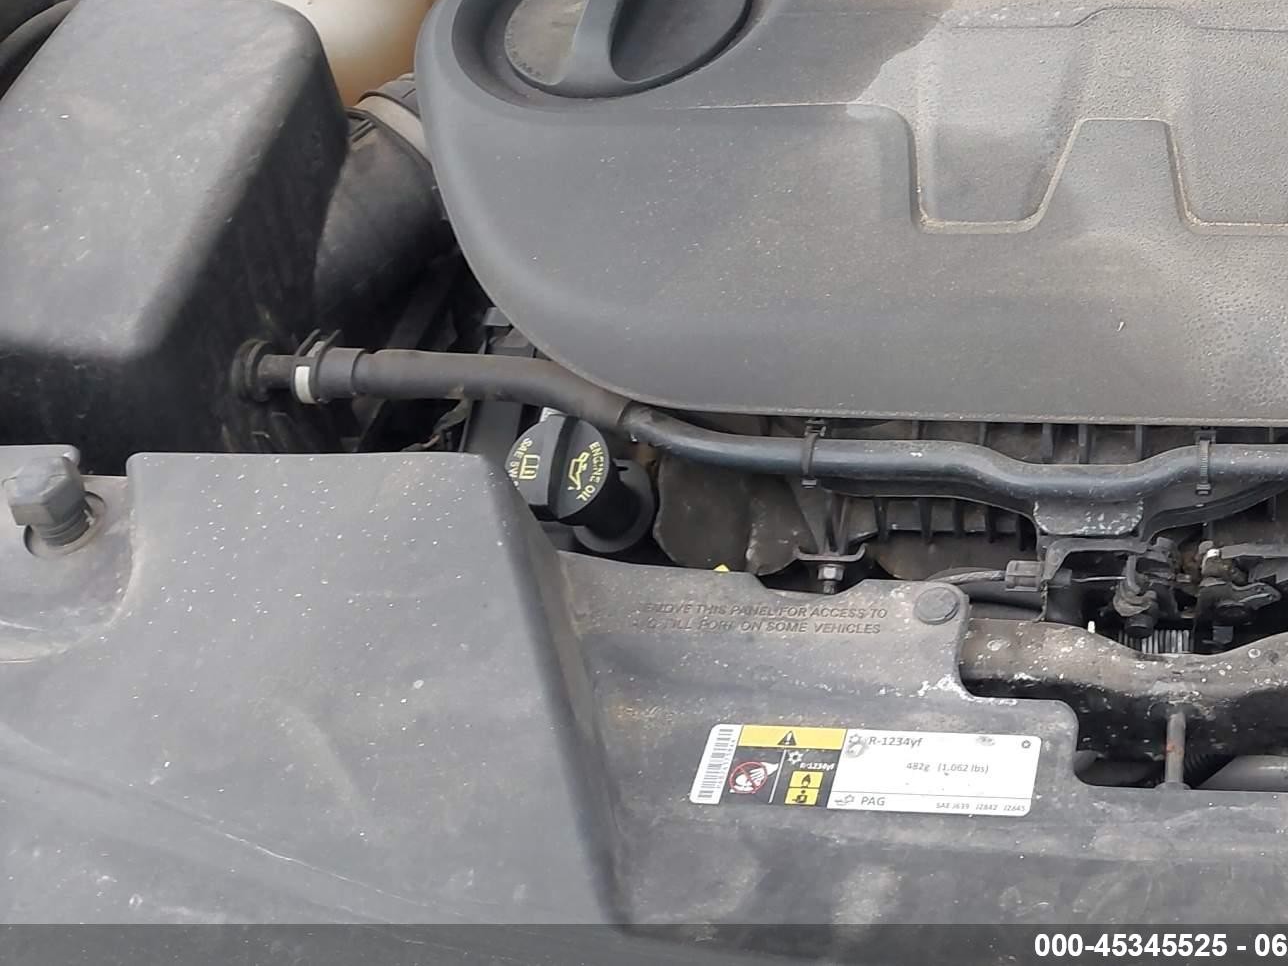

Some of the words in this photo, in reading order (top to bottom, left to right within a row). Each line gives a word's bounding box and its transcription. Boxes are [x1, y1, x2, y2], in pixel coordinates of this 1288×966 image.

[589, 441, 605, 483] ENGINE
[576, 484, 596, 501] OIL
[697, 601, 727, 615] THIS
[730, 603, 776, 617] PANEL
[778, 604, 808, 617] FOR
[809, 607, 867, 619] ACCESS
[869, 608, 888, 619] TO
[766, 621, 808, 633] SOME
[814, 623, 881, 634] VEHICLES
[868, 736, 923, 748] R-1234yf
[861, 796, 886, 808] PAG
